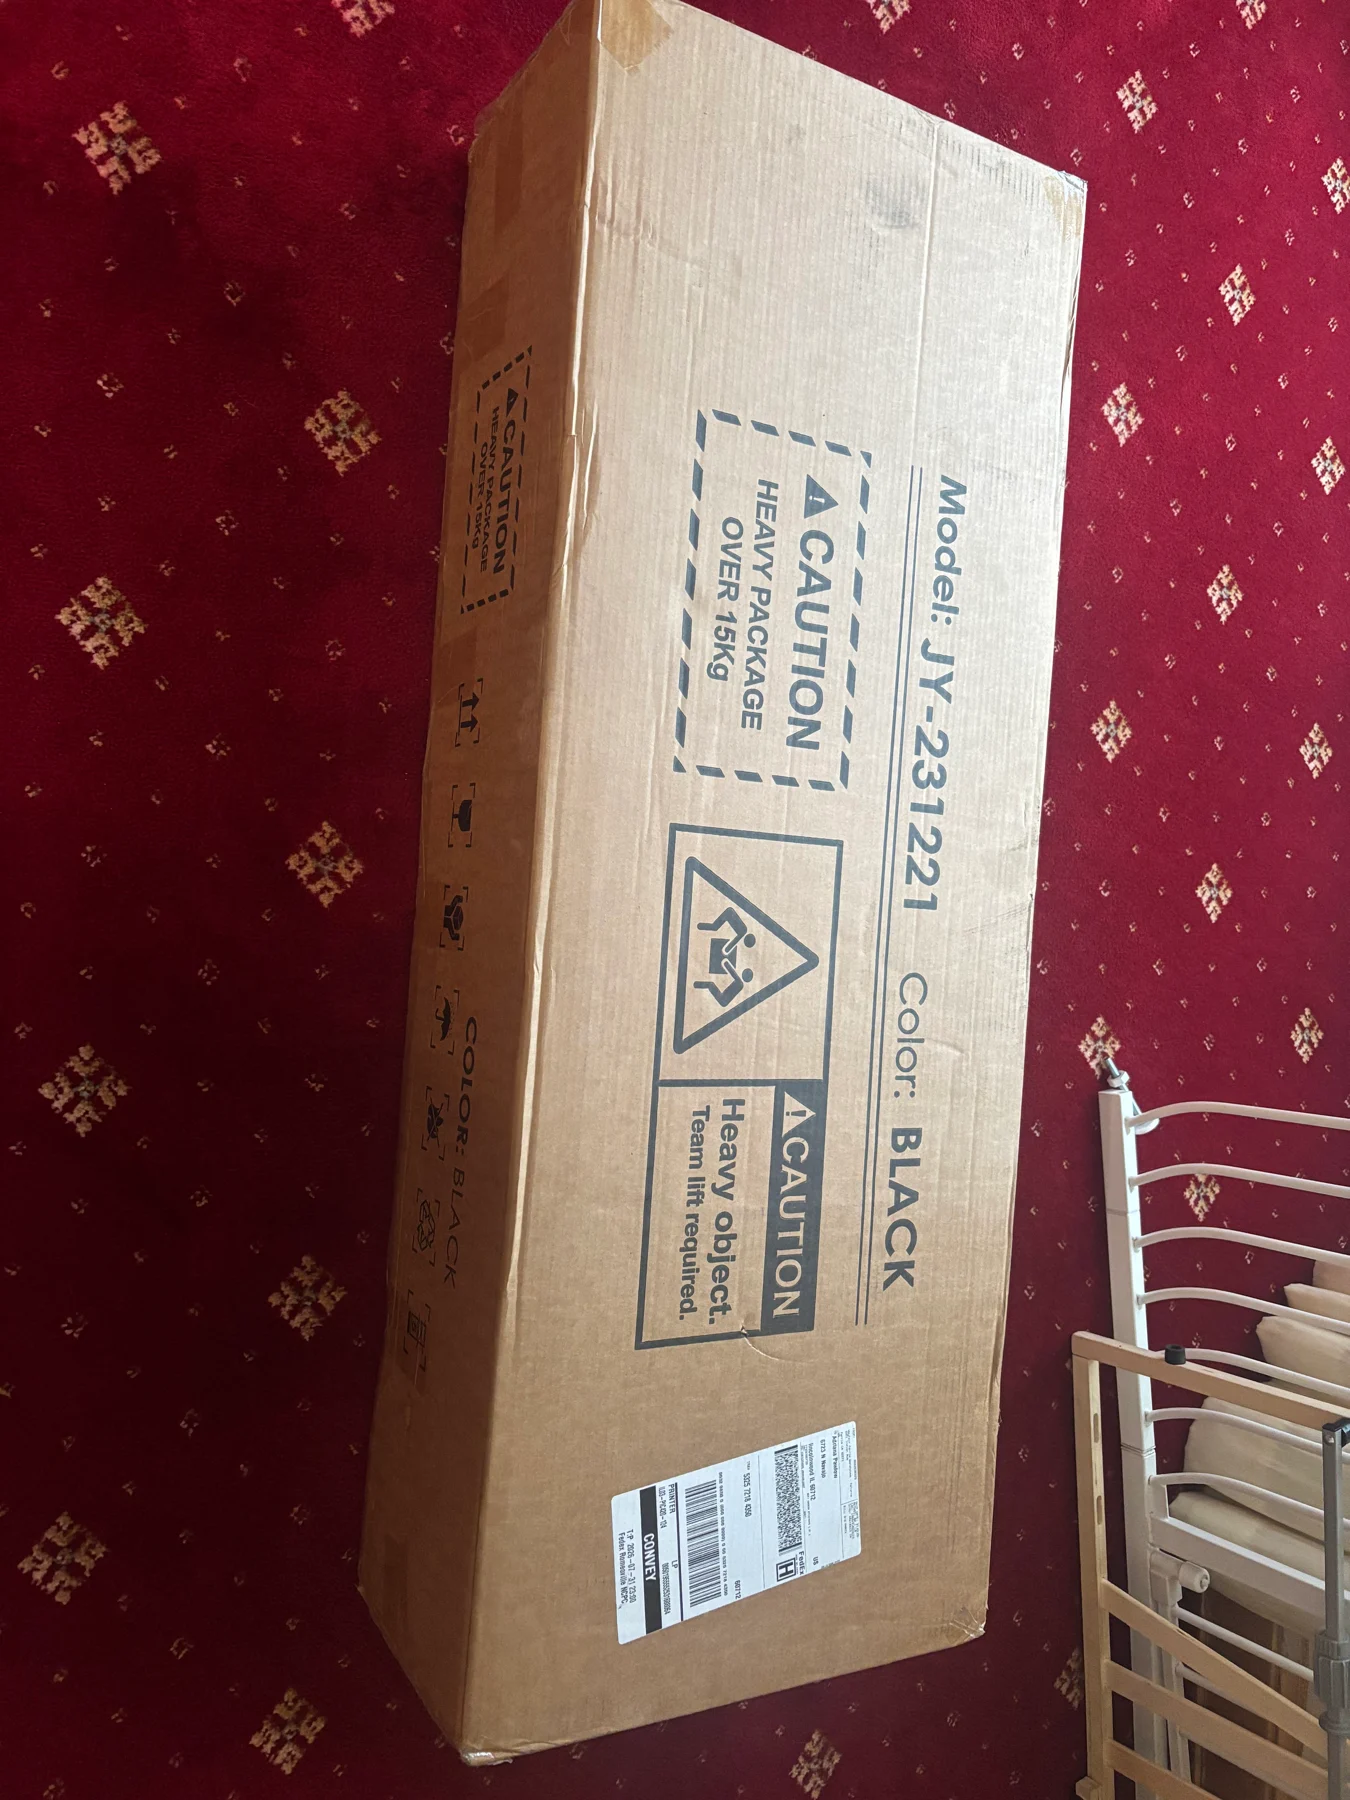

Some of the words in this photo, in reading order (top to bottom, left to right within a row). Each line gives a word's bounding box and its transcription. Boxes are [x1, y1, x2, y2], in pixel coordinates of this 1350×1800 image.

[477, 441, 488, 497] OVER
[487, 405, 500, 470] HEAVY
[479, 476, 495, 573] PACKAGE
[493, 419, 516, 575] CAUTION
[753, 479, 779, 581] HEAVY
[717, 516, 744, 601] OVER
[930, 474, 967, 626] Model:
[706, 611, 737, 681] 15Kg
[741, 585, 771, 730] PACKAGE
[785, 529, 835, 750] CAUTION
[903, 637, 955, 910] JY-231221
[893, 972, 928, 1098] Color:
[454, 1015, 478, 1158] COLOR:
[688, 1104, 711, 1170] Team
[711, 1098, 746, 1201] Heavy
[443, 1166, 465, 1290] BLACK
[685, 1177, 706, 1207] lift
[772, 1136, 810, 1318] CAUTION
[882, 1127, 923, 1292] BLACK
[679, 1212, 700, 1321] required.
[706, 1211, 738, 1325] object.
[617, 1532, 626, 1551] Fedex
[667, 1483, 675, 1514] PRINTER
[743, 1487, 751, 1502] 7218
[642, 1532, 657, 1583] CONVEY
[671, 1559, 677, 1569] LP
[778, 1562, 795, 1579] H
[812, 1556, 818, 1565] US
